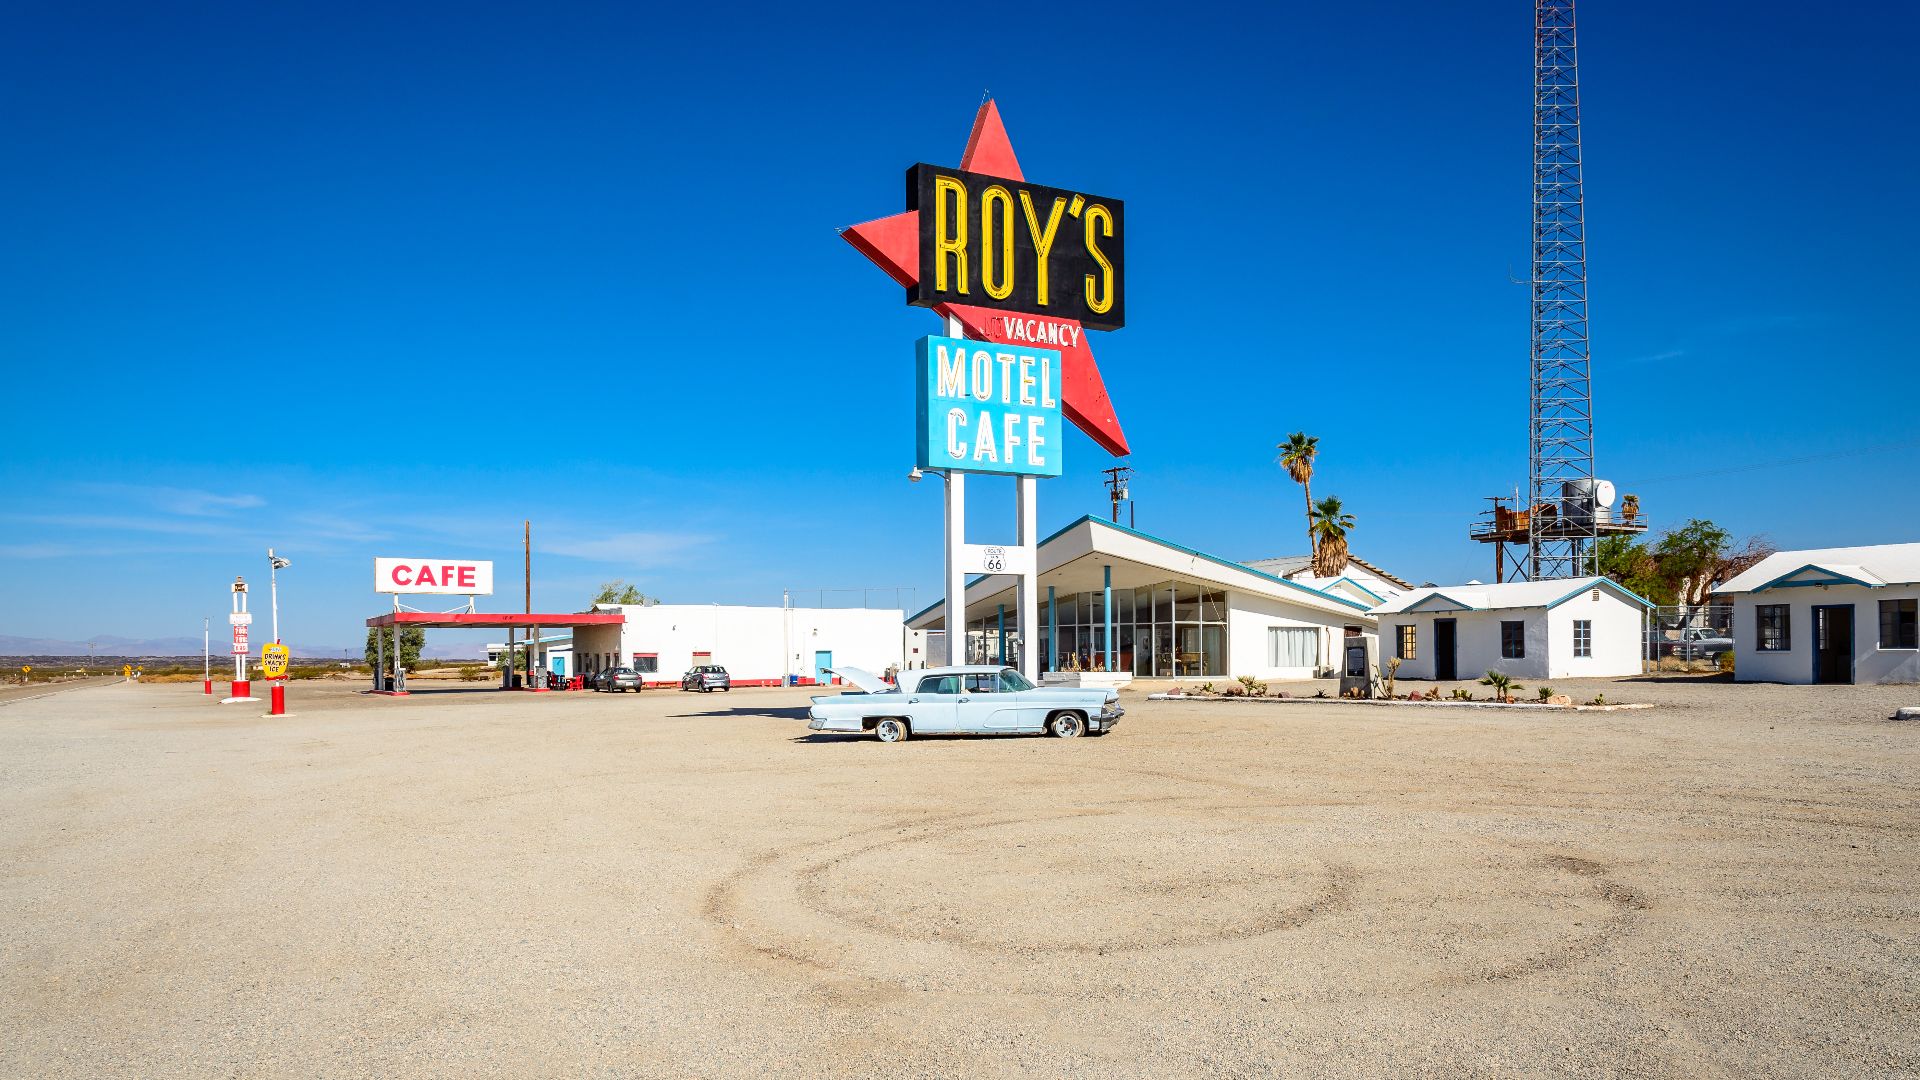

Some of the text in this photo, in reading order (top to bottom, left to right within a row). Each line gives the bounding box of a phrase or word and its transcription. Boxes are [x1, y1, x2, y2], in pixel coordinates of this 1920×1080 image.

[935, 175, 1114, 315] ROY'S
[1003, 316, 1083, 348] VACANCY
[937, 345, 1056, 409] MOTEL
[947, 407, 1045, 466] CAFE
[391, 564, 476, 588] CAFE
[988, 559, 1002, 570] 66
